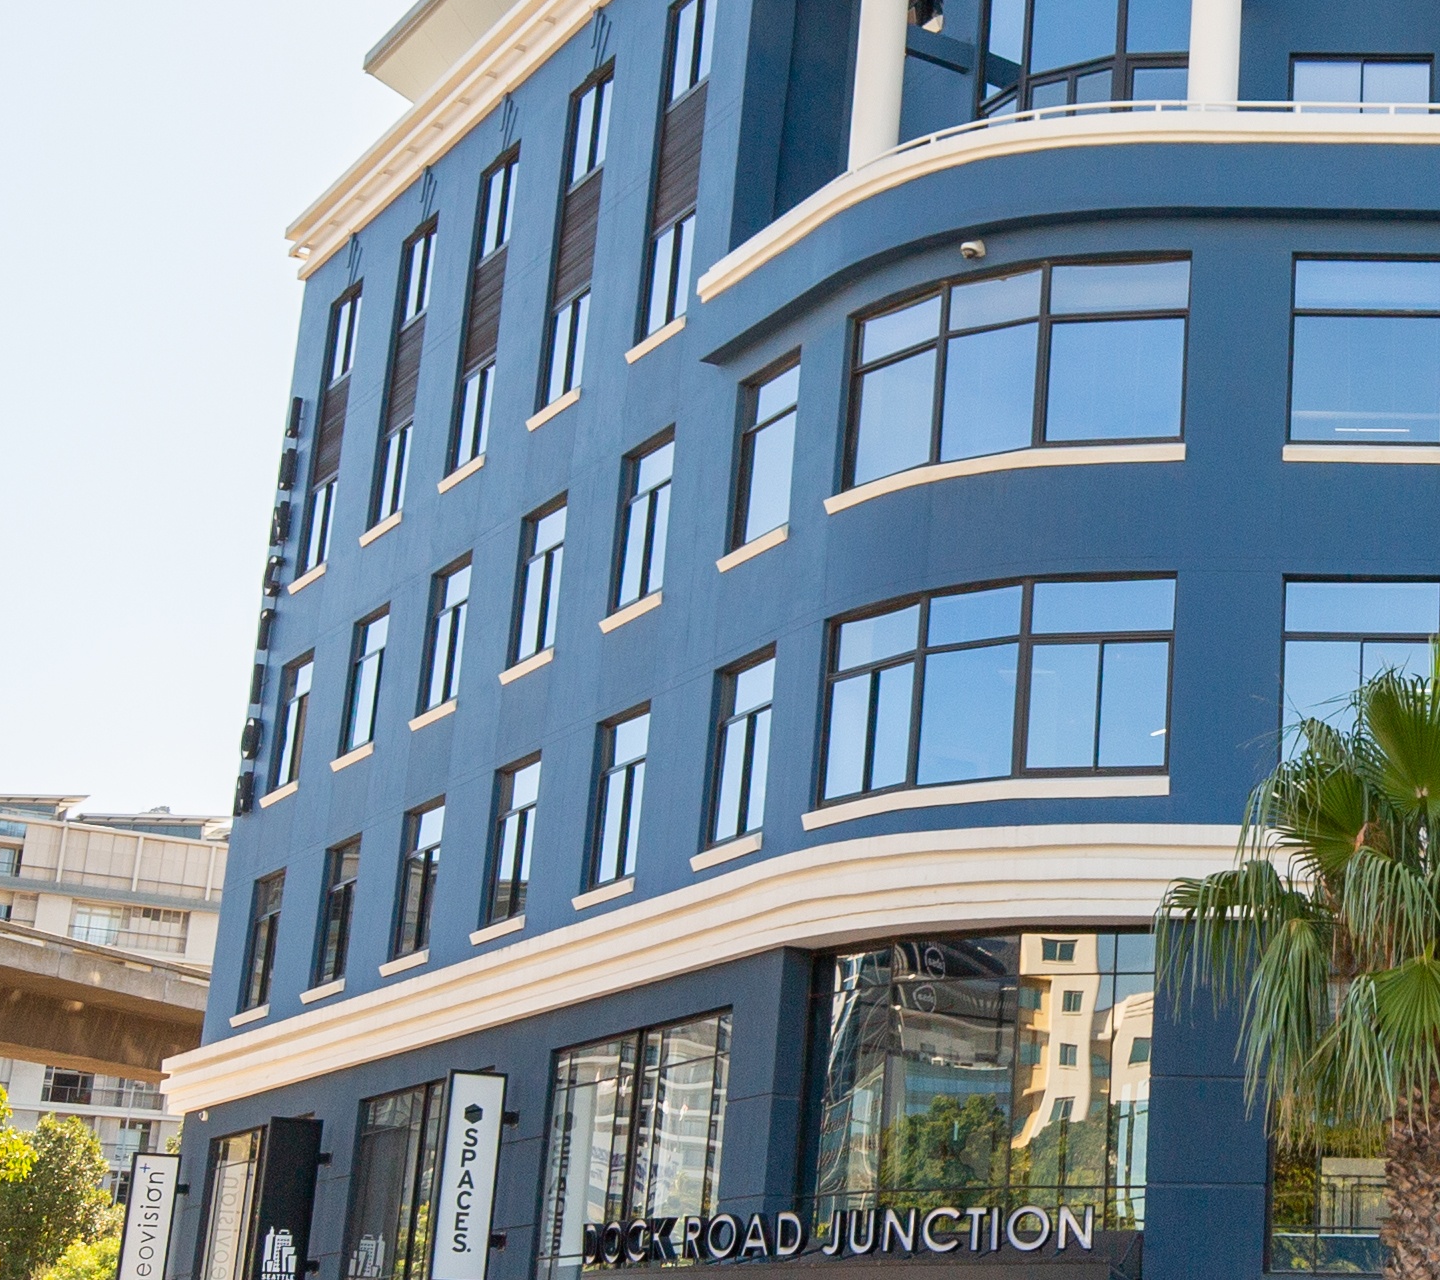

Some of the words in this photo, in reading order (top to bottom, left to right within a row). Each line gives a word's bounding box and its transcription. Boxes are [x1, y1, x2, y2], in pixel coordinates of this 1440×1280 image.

[451, 1127, 479, 1254] SPACES.
[582, 1217, 677, 1265] DOCK
[683, 1211, 804, 1261] ROAD
[822, 1204, 1096, 1256] JUNCTION
[261, 1273, 296, 1280] SEATTLE
